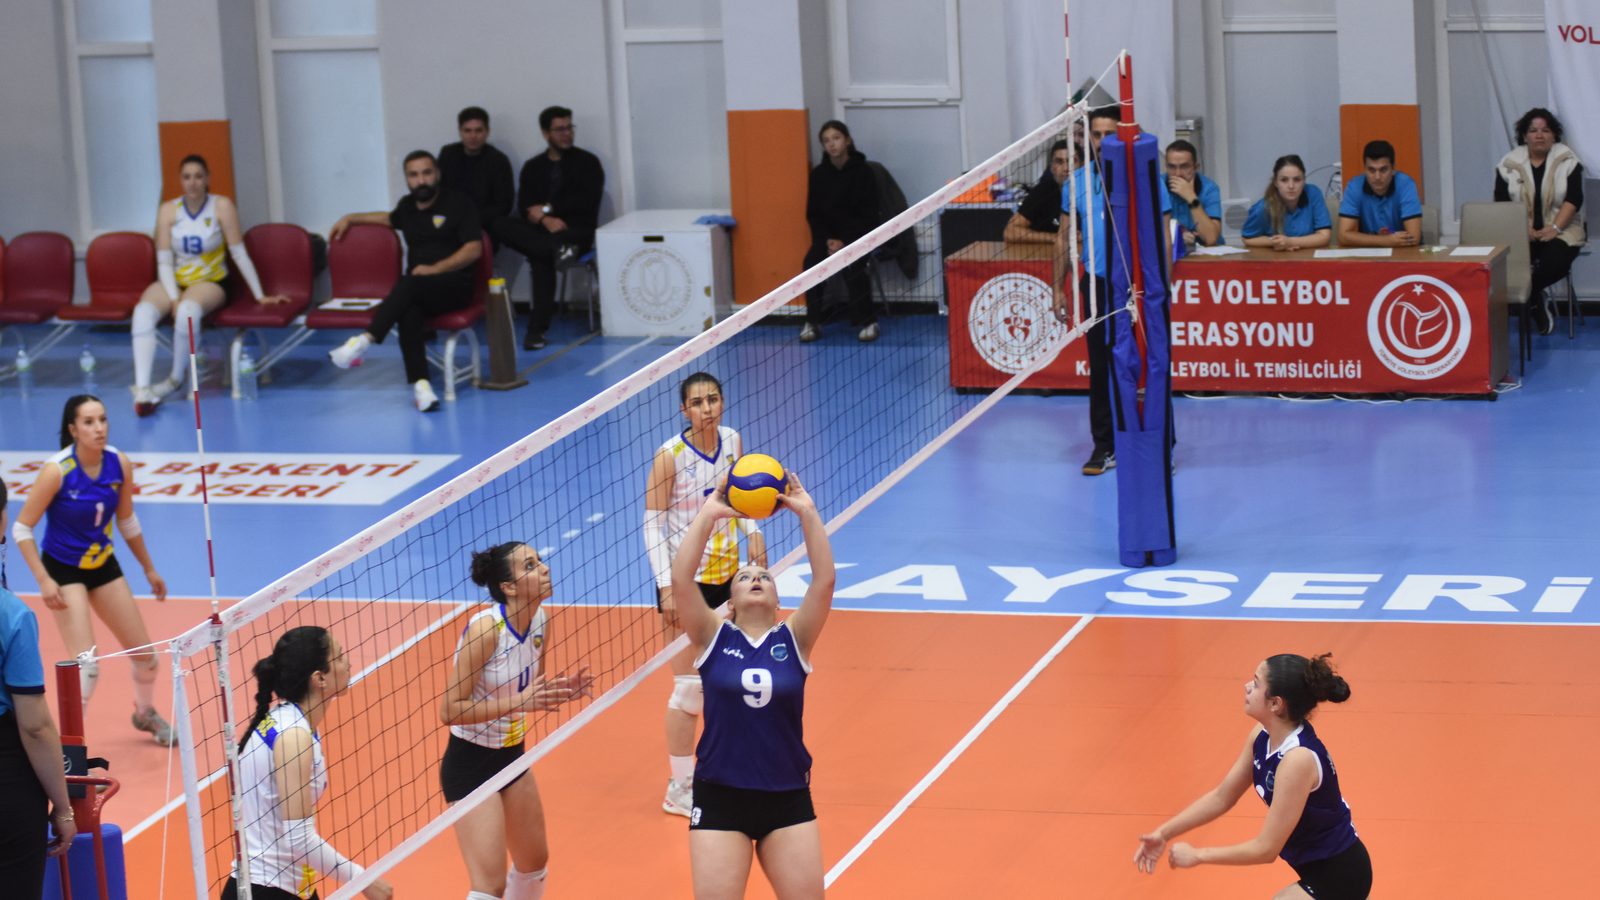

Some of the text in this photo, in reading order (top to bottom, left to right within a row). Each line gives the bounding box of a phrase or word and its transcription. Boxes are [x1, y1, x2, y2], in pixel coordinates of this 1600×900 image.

[183, 235, 203, 255] 13
[1208, 279, 1350, 305] VOLEYBOL
[1171, 322, 1314, 347] ERASYONU
[1170, 359, 1362, 379] LEYBOL İL TEMSİLCİLİĞİ
[152, 460, 420, 479] BAŞKENTİ
[94, 502, 104, 528] 1
[741, 667, 773, 709] 9
